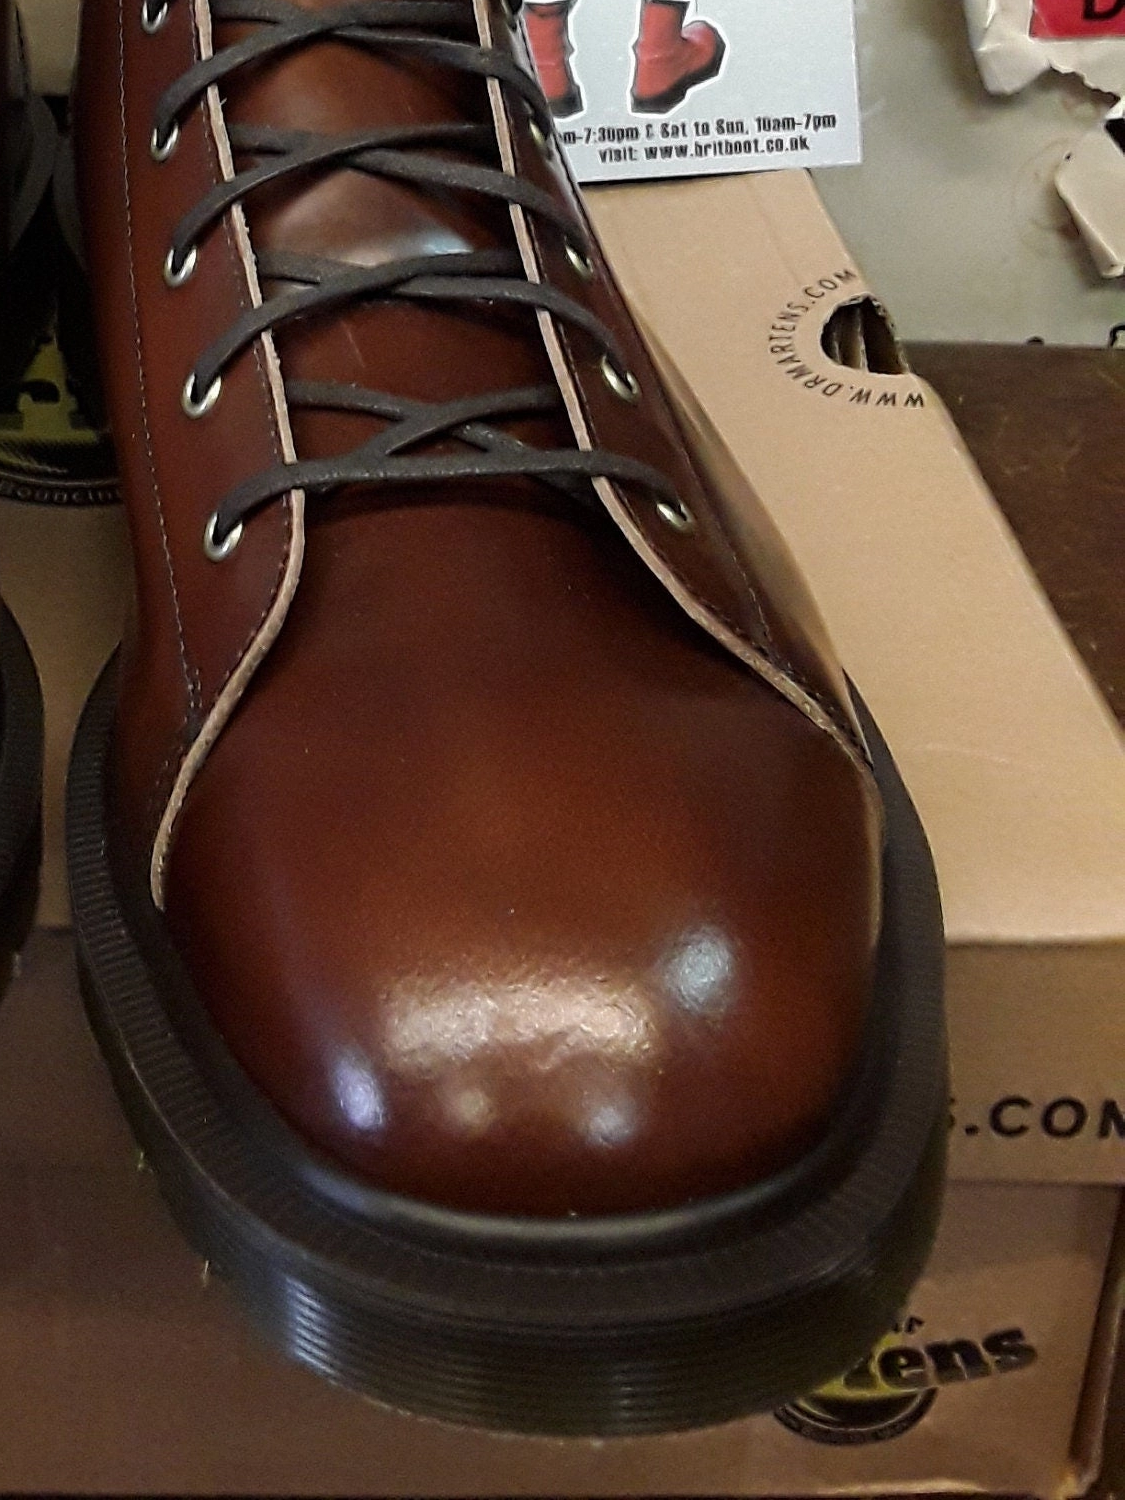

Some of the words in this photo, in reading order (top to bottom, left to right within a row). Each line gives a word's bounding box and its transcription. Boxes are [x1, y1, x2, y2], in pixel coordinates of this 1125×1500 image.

[660, 122, 688, 140] Sat
[694, 121, 710, 137] to
[645, 136, 811, 161] www.britboot.co.uk
[963, 1095, 1125, 1140] .COM
